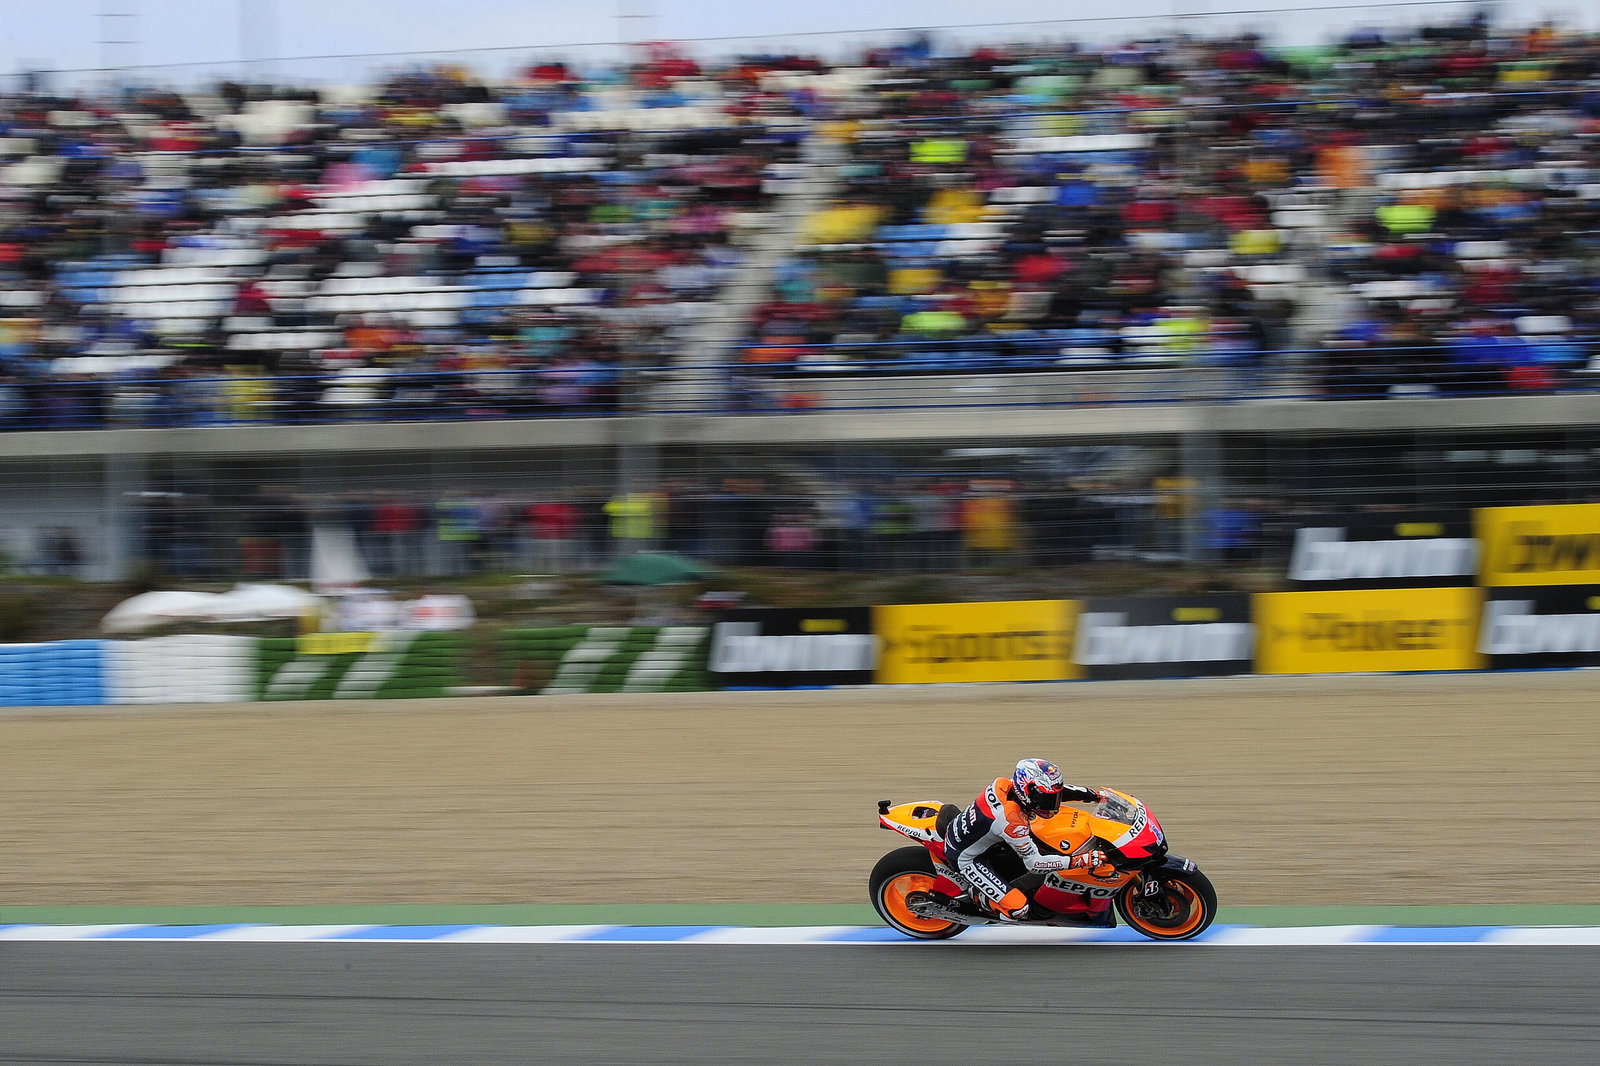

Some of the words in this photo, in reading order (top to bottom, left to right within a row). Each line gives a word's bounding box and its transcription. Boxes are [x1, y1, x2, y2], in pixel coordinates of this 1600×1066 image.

[897, 825, 922, 838] REPSOL
[966, 866, 1000, 901] REPSOL
[975, 863, 1007, 892] HONDA
